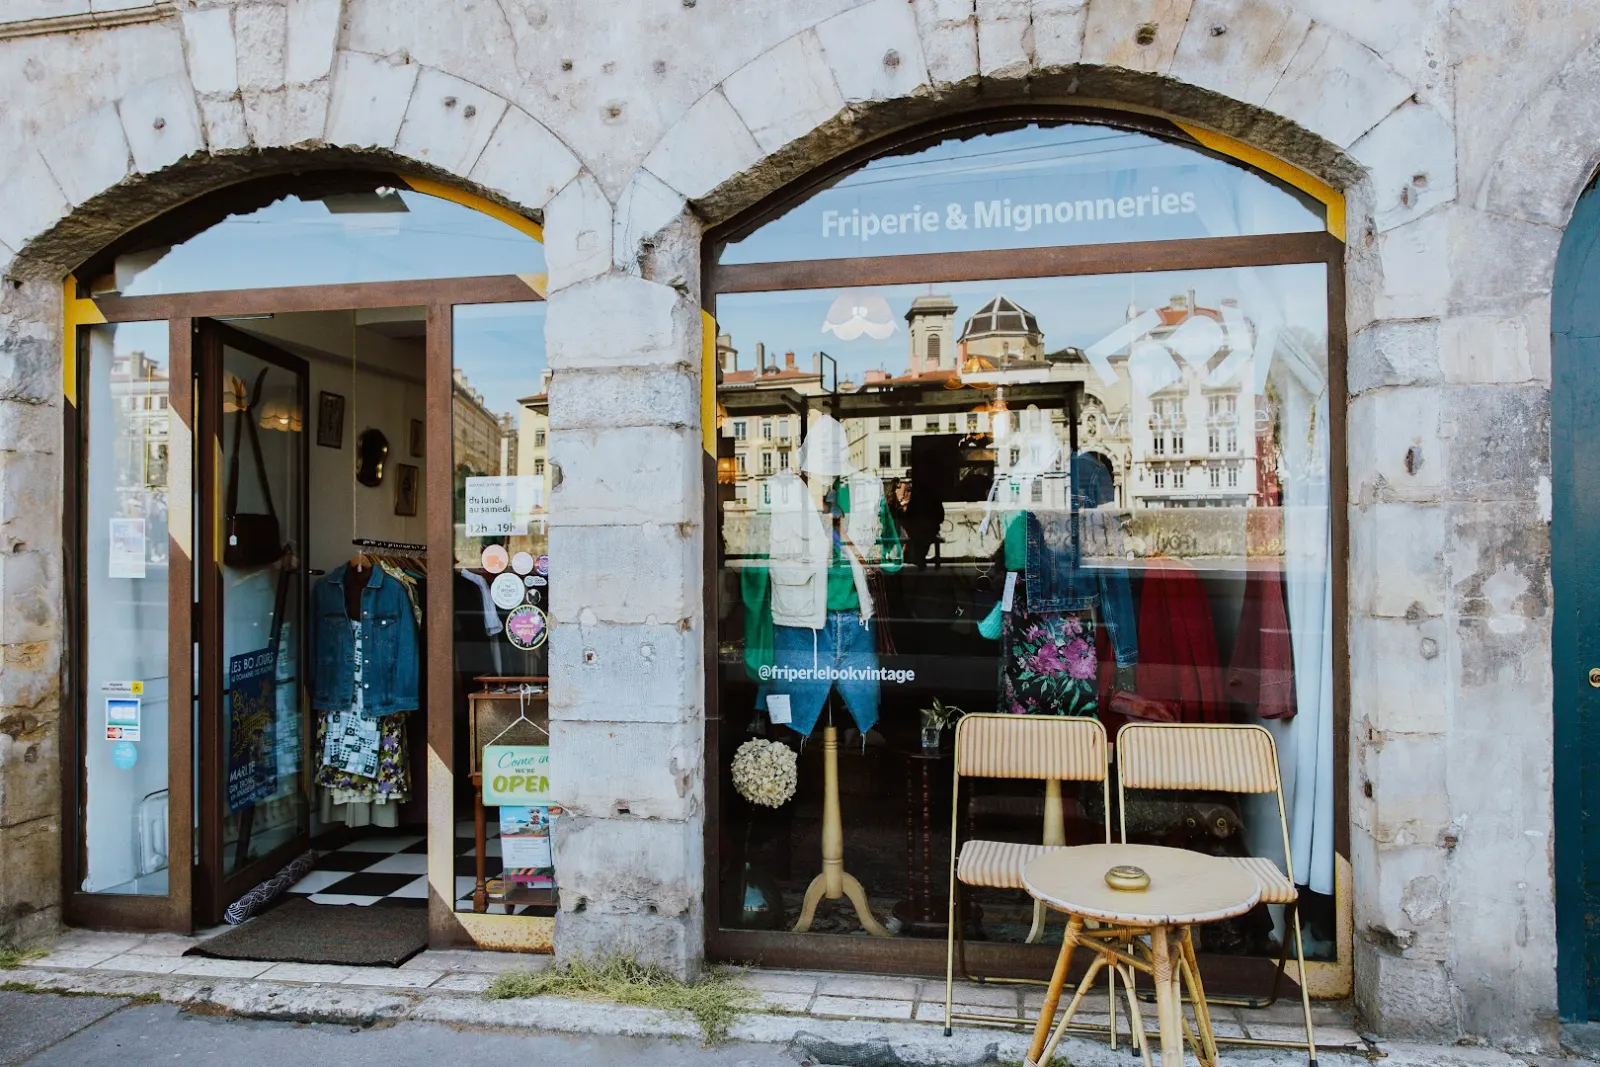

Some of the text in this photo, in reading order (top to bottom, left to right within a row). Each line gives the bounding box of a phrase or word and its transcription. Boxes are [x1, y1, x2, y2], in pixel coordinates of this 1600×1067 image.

[822, 187, 1197, 241] Friperie & Mignonneries
[469, 496, 502, 504] du lundi
[481, 505, 511, 513] samedi
[758, 665, 915, 683] @friperielookvintage
[498, 751, 534, 769] Come
